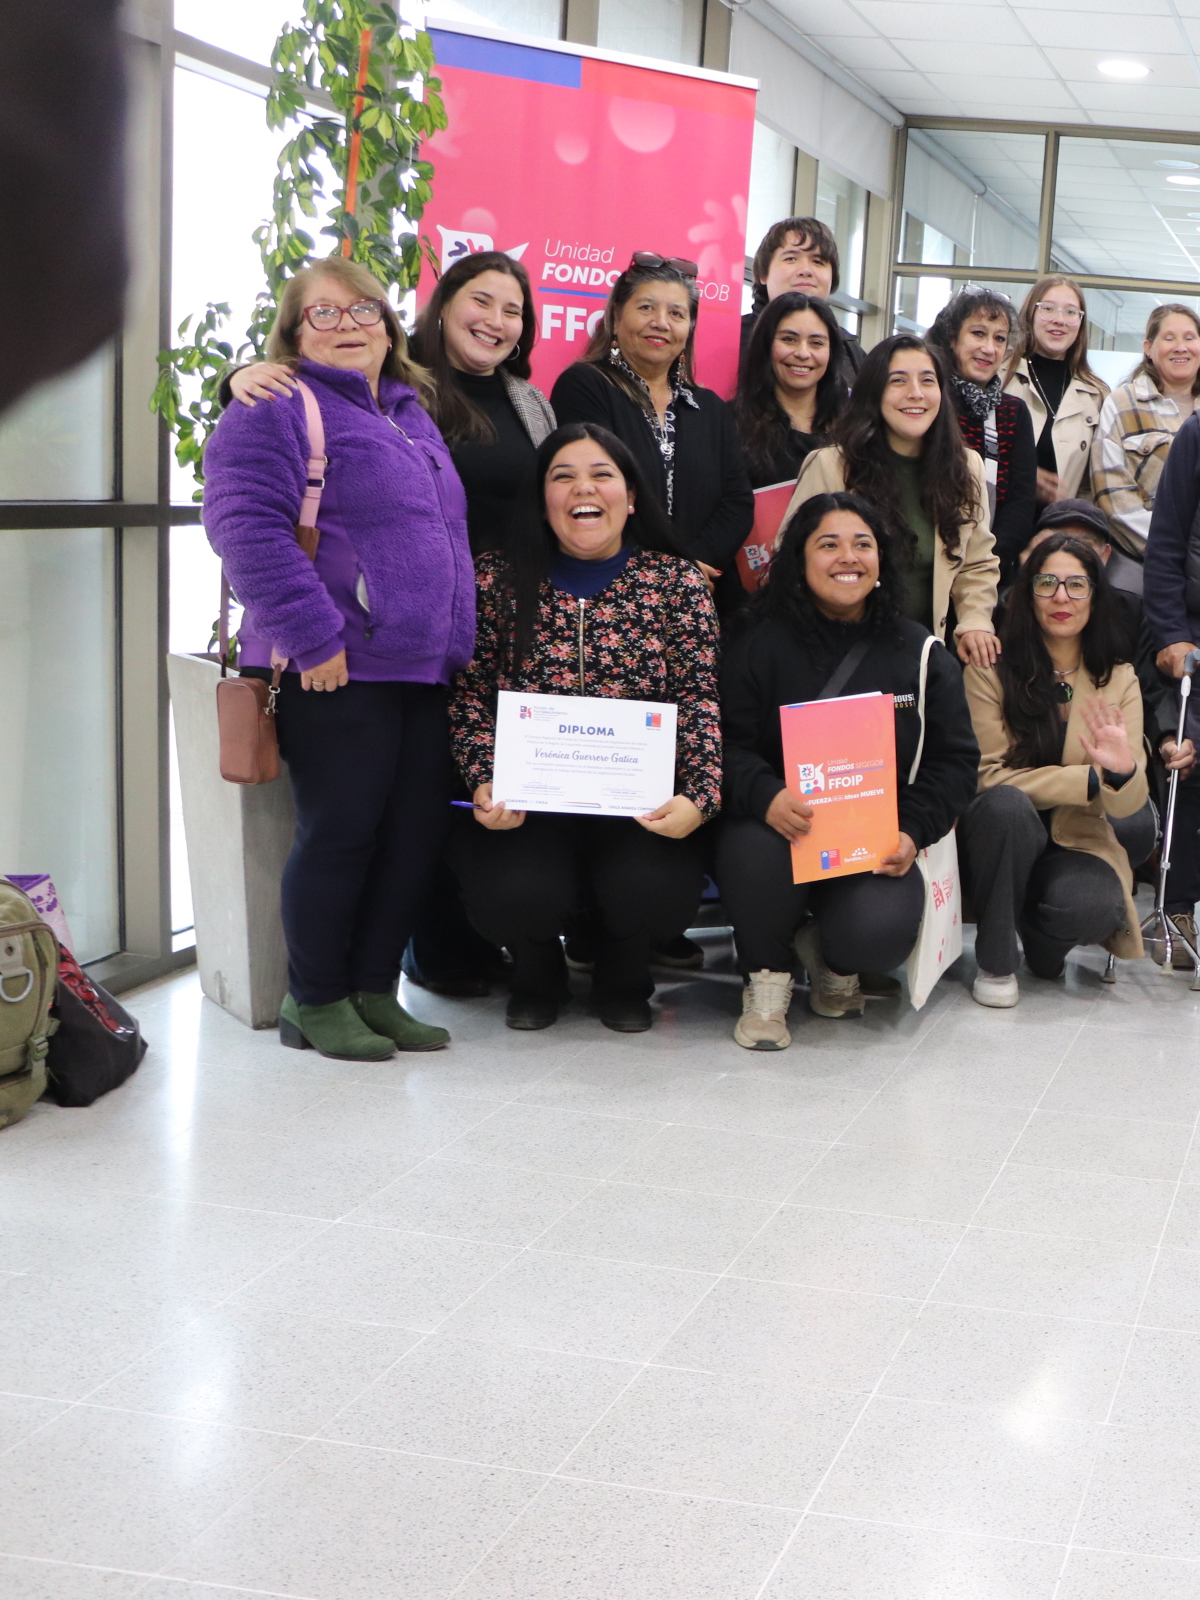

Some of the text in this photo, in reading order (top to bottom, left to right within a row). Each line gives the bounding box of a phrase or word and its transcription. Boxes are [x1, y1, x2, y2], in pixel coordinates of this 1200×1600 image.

[544, 238, 615, 264] Unidad
[541, 262, 623, 288] FONDO
[558, 724, 615, 737] DIPLOMA
[534, 747, 640, 764] Verónica Guerrero Gatica
[827, 758, 848, 766] Unidad
[827, 759, 884, 773] FONDOS SEGEGOB
[828, 774, 864, 790] FFOIP
[808, 797, 833, 806] FUERZA
